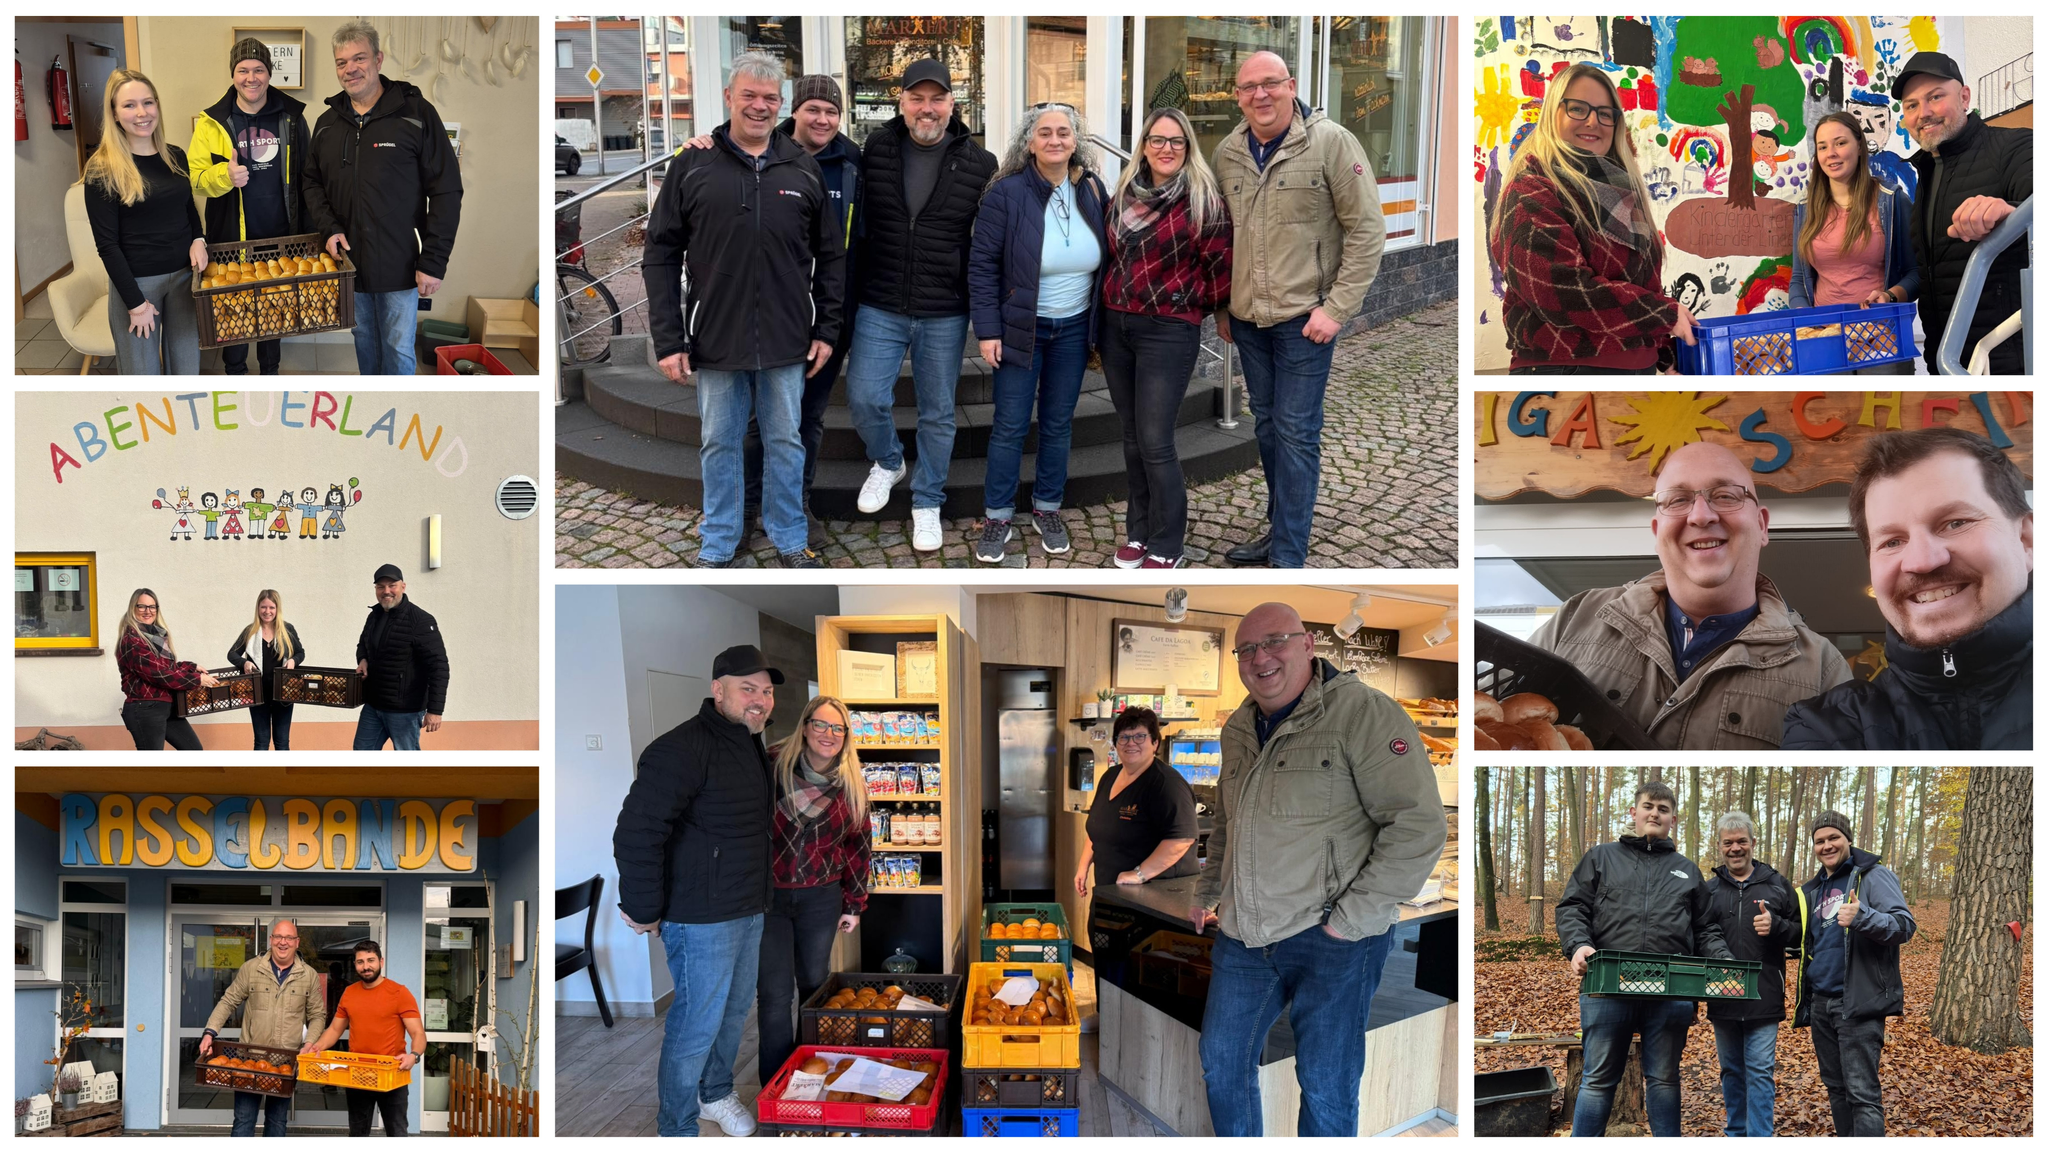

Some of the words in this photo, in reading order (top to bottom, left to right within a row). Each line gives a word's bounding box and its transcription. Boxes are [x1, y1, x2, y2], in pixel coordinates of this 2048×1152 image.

[1690, 204, 1794, 233] Kindergarten
[50, 391, 468, 484] ABENTEUERLAND
[1740, 391, 2033, 473] SCHEI
[61, 793, 475, 871] RASSELBANDE
